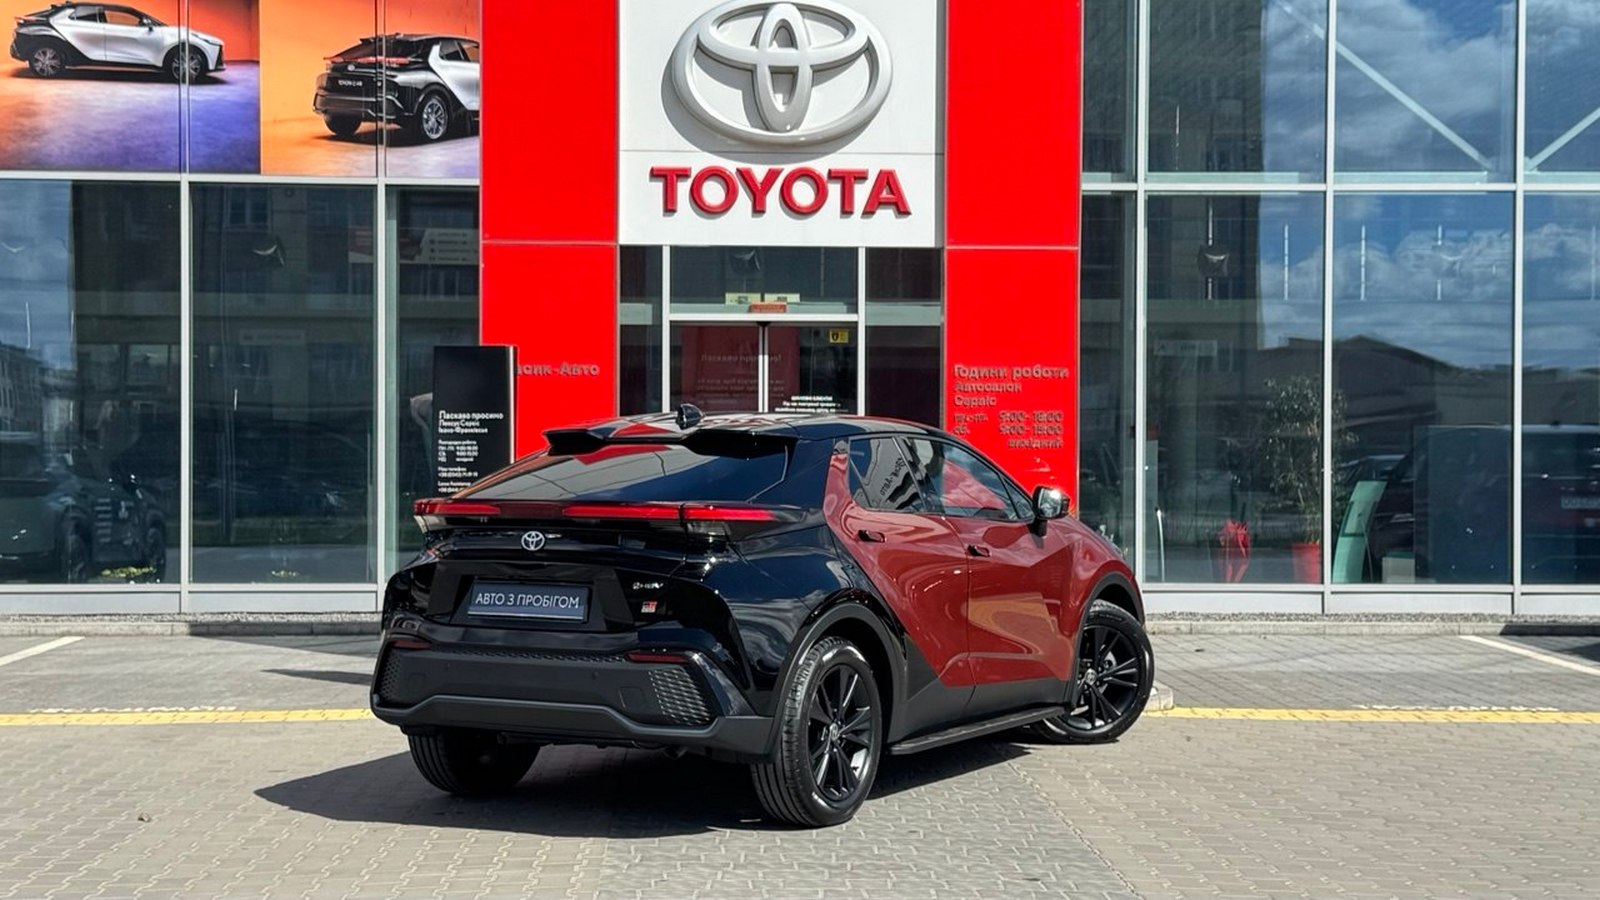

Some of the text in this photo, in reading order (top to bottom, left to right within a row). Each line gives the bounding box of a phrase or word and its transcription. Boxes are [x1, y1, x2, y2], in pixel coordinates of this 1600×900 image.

[650, 165, 912, 216] TOYOTA
[954, 363, 1070, 380] Години роботи
[955, 382, 1022, 394] Автосалон
[954, 395, 997, 408] Сервіс
[475, 593, 580, 609] АВТО З ПРОБІГОМ
